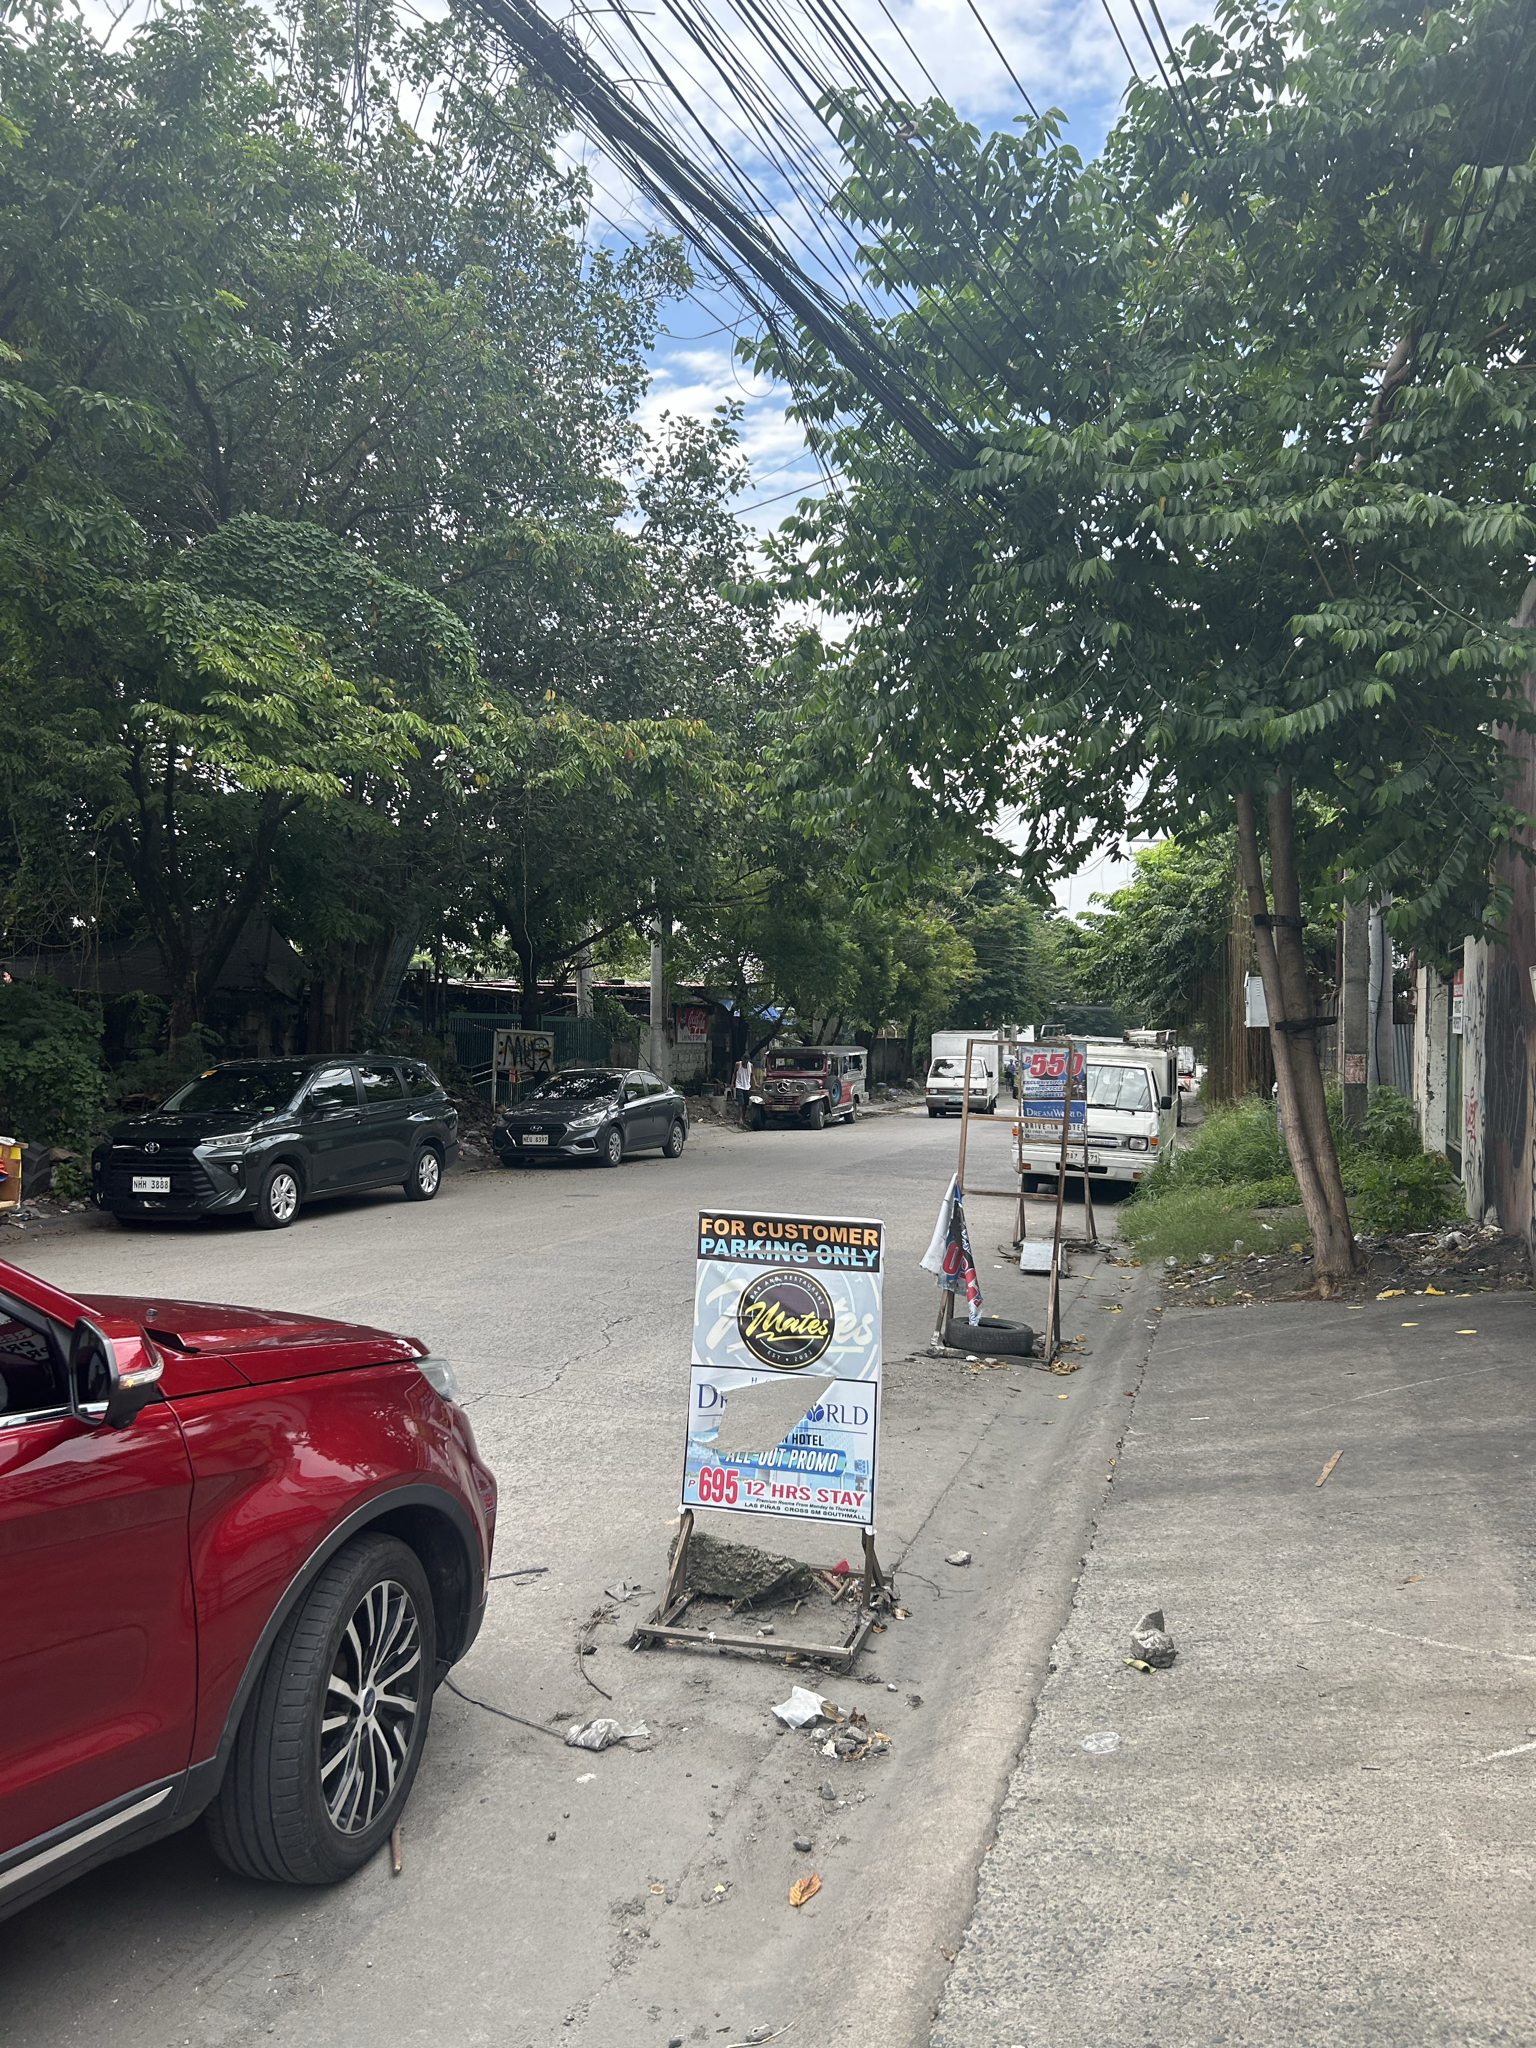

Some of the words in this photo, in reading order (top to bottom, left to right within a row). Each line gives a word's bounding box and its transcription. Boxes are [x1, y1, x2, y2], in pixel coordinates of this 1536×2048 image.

[134, 1180, 147, 1189] NHH
[151, 1180, 169, 1189] 3888
[701, 1218, 746, 1236] FOR
[752, 1221, 879, 1247] CUSTOMER
[700, 1237, 809, 1263] PARKING
[816, 1244, 879, 1267] ONLY
[750, 1286, 762, 1300] BAR
[783, 1275, 825, 1305] RESTAURANT
[744, 1301, 829, 1337] Mates
[767, 1350, 781, 1360] EST
[791, 1434, 824, 1447] HOTEL
[787, 1450, 839, 1473] PROMO
[744, 1481, 765, 1496] 12
[771, 1484, 811, 1501] HRS
[817, 1488, 866, 1507] STAY
[760, 1503, 781, 1511] PIÑAS
[823, 1511, 867, 1520] SOUTHMALL
[809, 1503, 828, 1511] Monday
[835, 1506, 858, 1514] Thursday
